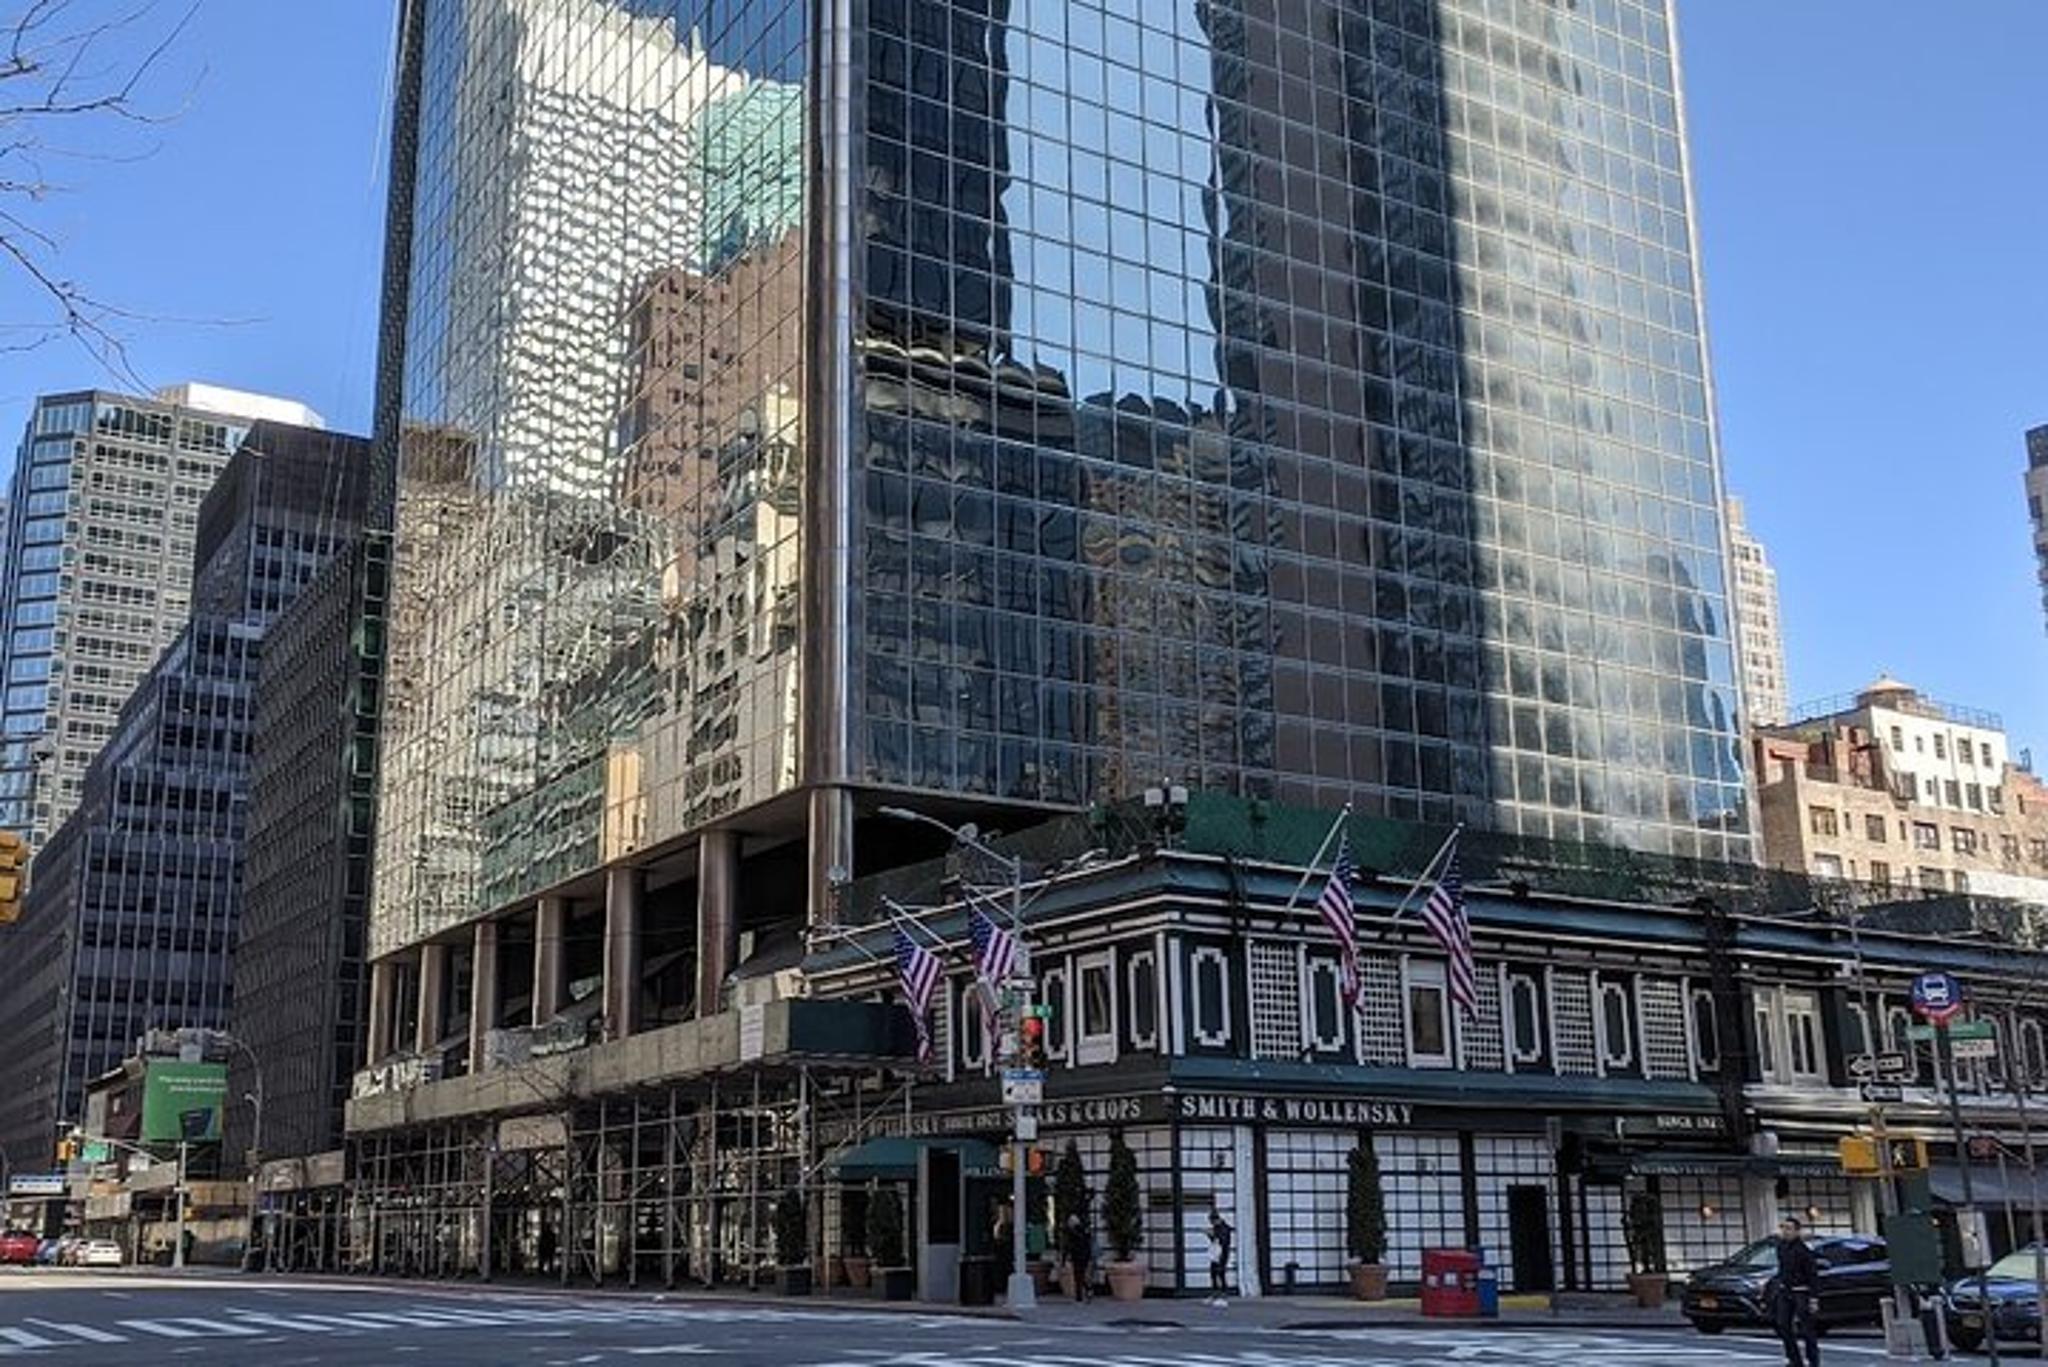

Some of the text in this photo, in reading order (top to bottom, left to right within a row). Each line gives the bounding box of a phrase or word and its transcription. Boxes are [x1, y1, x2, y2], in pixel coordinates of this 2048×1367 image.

[1085, 1098, 1141, 1122] CHOPS
[1182, 1095, 1413, 1124] SMITH & WOLLENSKY
